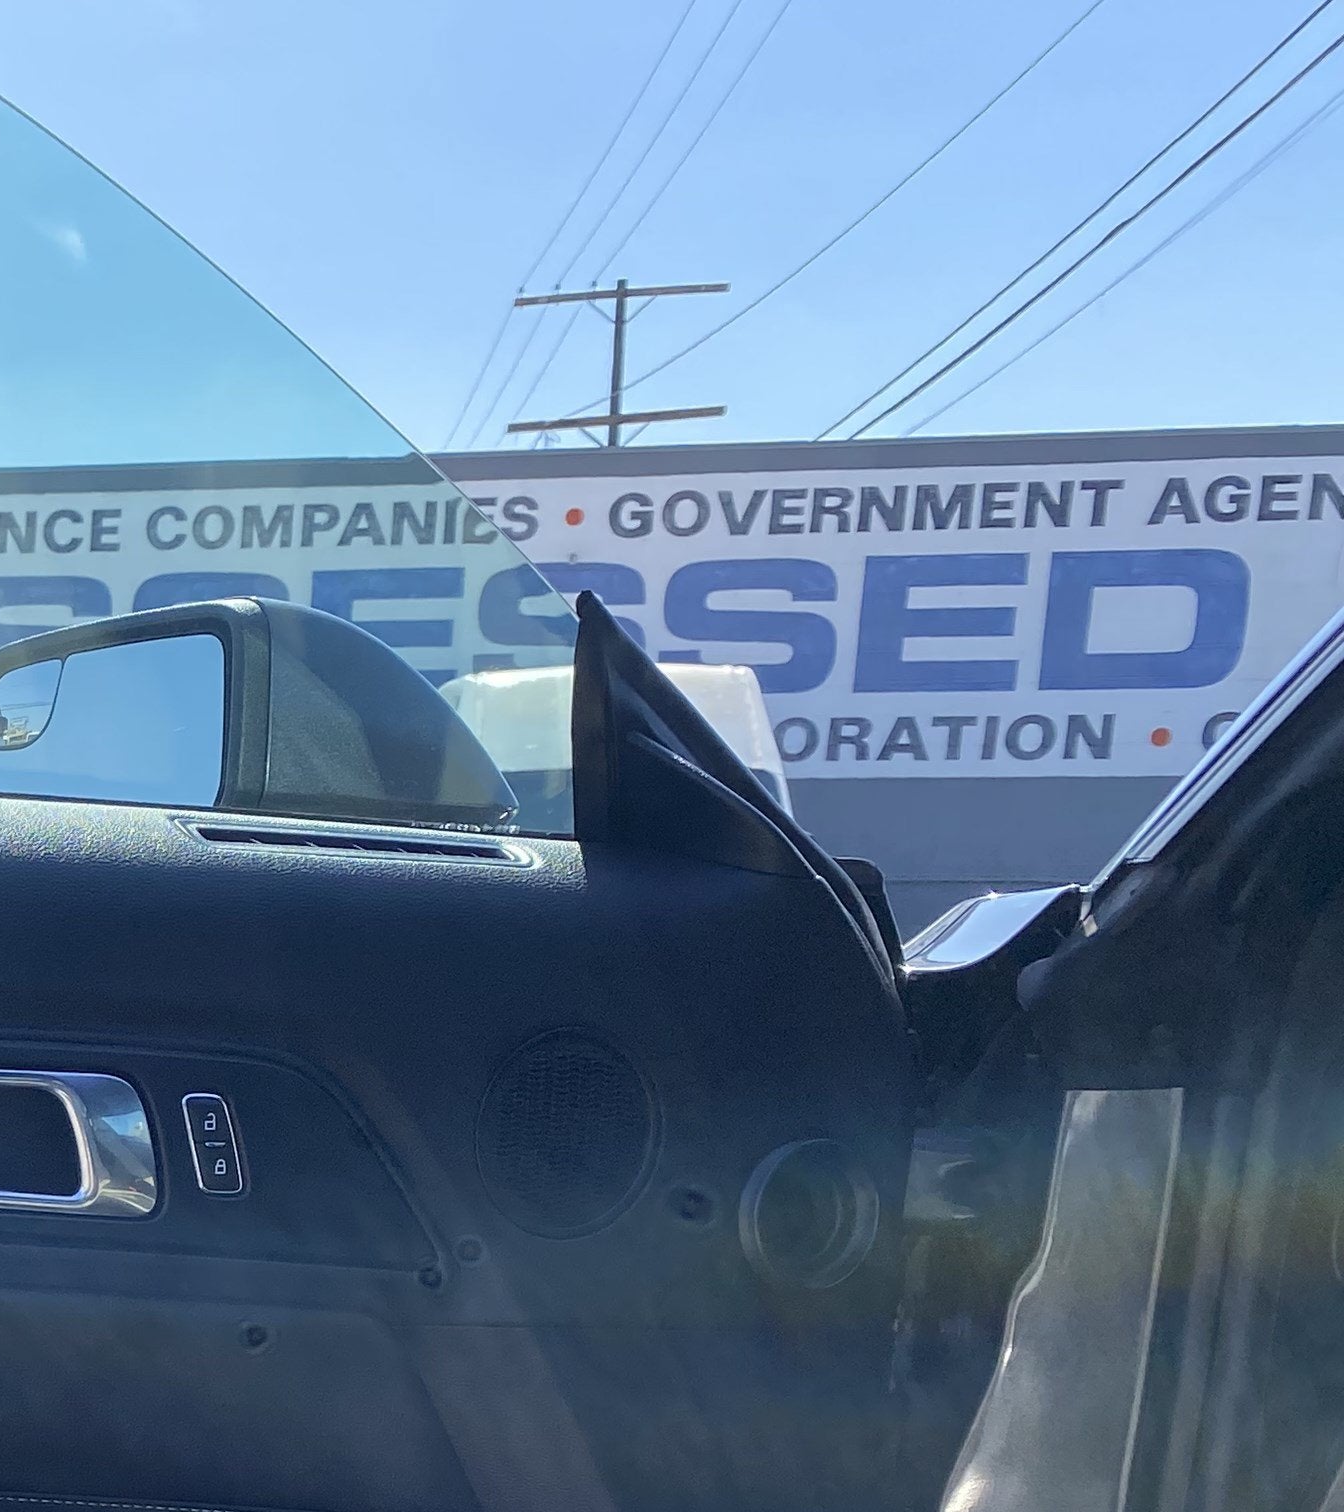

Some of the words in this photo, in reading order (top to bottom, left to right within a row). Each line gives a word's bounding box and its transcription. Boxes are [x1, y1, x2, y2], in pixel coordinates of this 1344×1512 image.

[146, 496, 540, 551] COMPANIES
[609, 479, 1125, 538] GOVERNMENT
[773, 712, 1117, 764] ORATION
